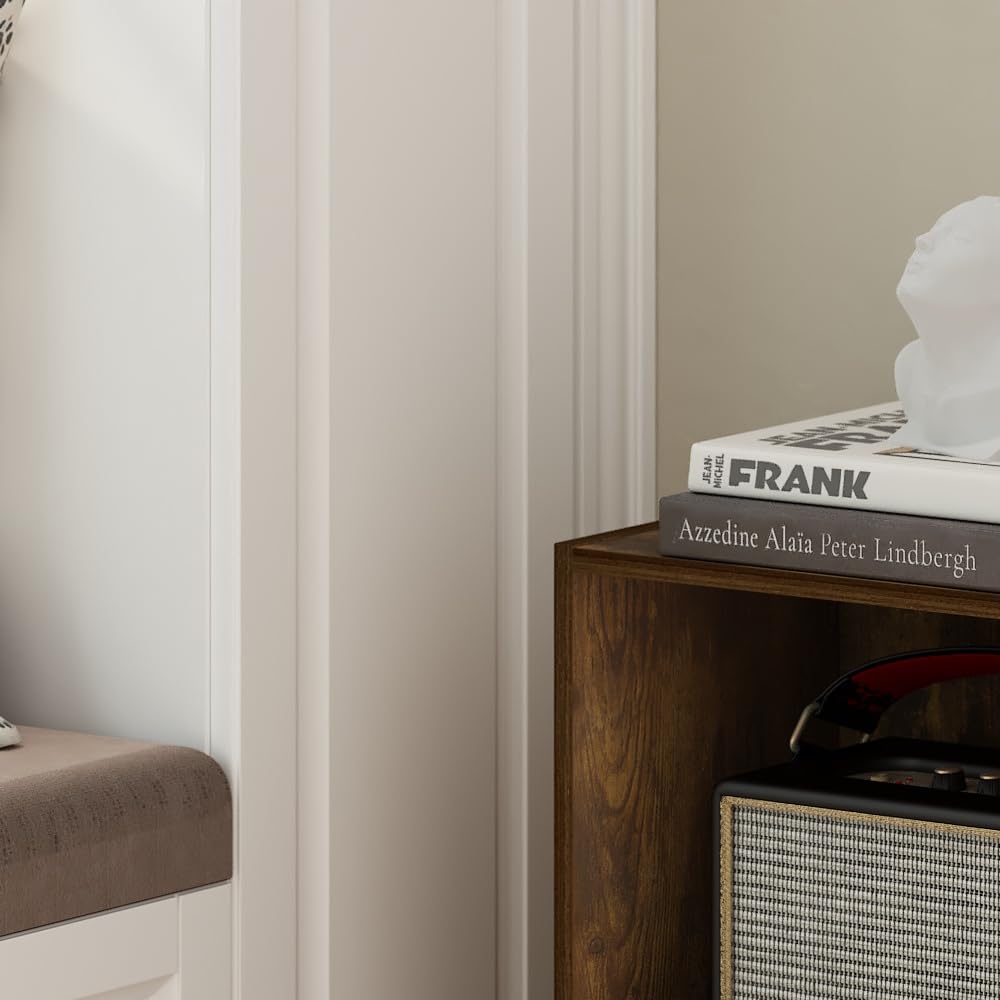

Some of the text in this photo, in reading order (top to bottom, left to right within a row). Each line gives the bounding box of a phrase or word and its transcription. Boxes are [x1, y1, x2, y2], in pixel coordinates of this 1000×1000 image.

[784, 419, 908, 451] FRA
[702, 454, 712, 484] JEAN-
[713, 453, 724, 488] MICHEL
[729, 458, 871, 500] FRANK
[679, 517, 977, 579] Azzedine Alaïa Peter Lindbergh
